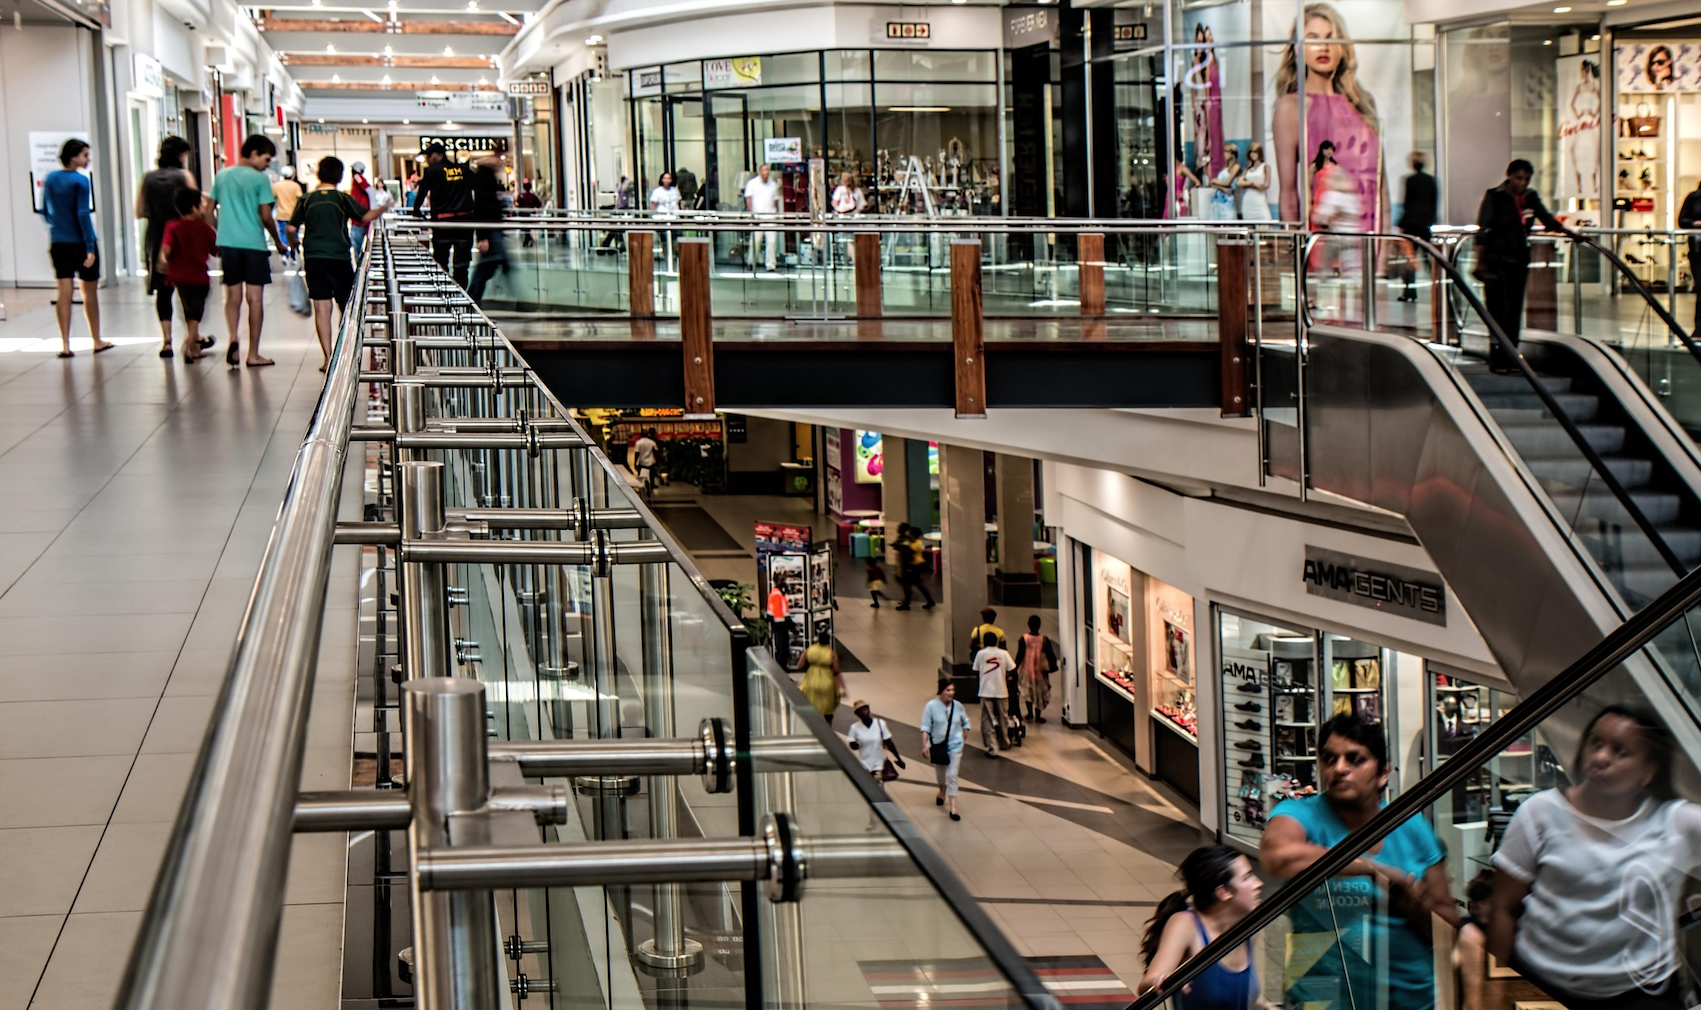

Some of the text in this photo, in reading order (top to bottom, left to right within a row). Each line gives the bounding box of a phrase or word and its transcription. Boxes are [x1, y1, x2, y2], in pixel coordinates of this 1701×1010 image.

[705, 60, 731, 73] LOVE
[1303, 559, 1439, 614] AMA GENTS
